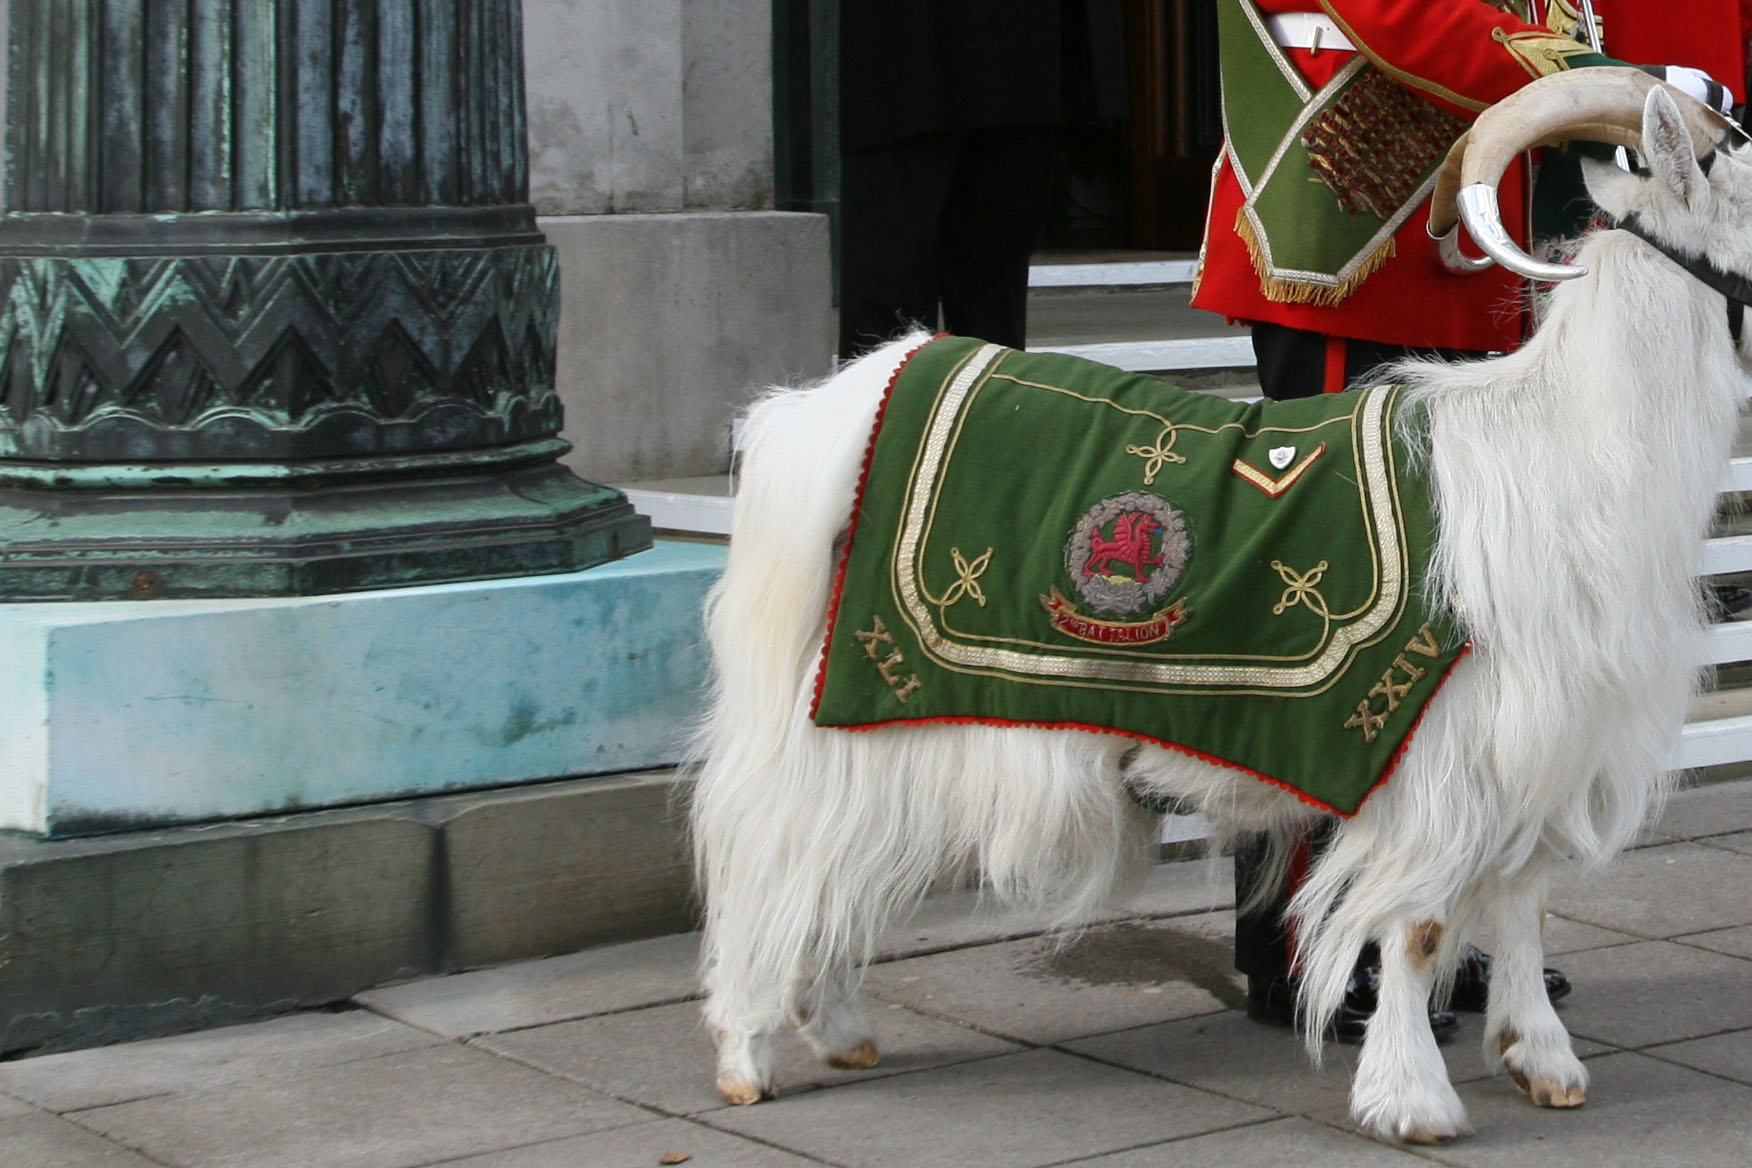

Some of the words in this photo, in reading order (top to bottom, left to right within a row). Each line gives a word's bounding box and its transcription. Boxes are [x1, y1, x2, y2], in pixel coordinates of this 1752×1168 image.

[854, 614, 921, 704] XLI
[1079, 622, 1160, 642] BATTALION
[1343, 622, 1442, 743] XXIV
